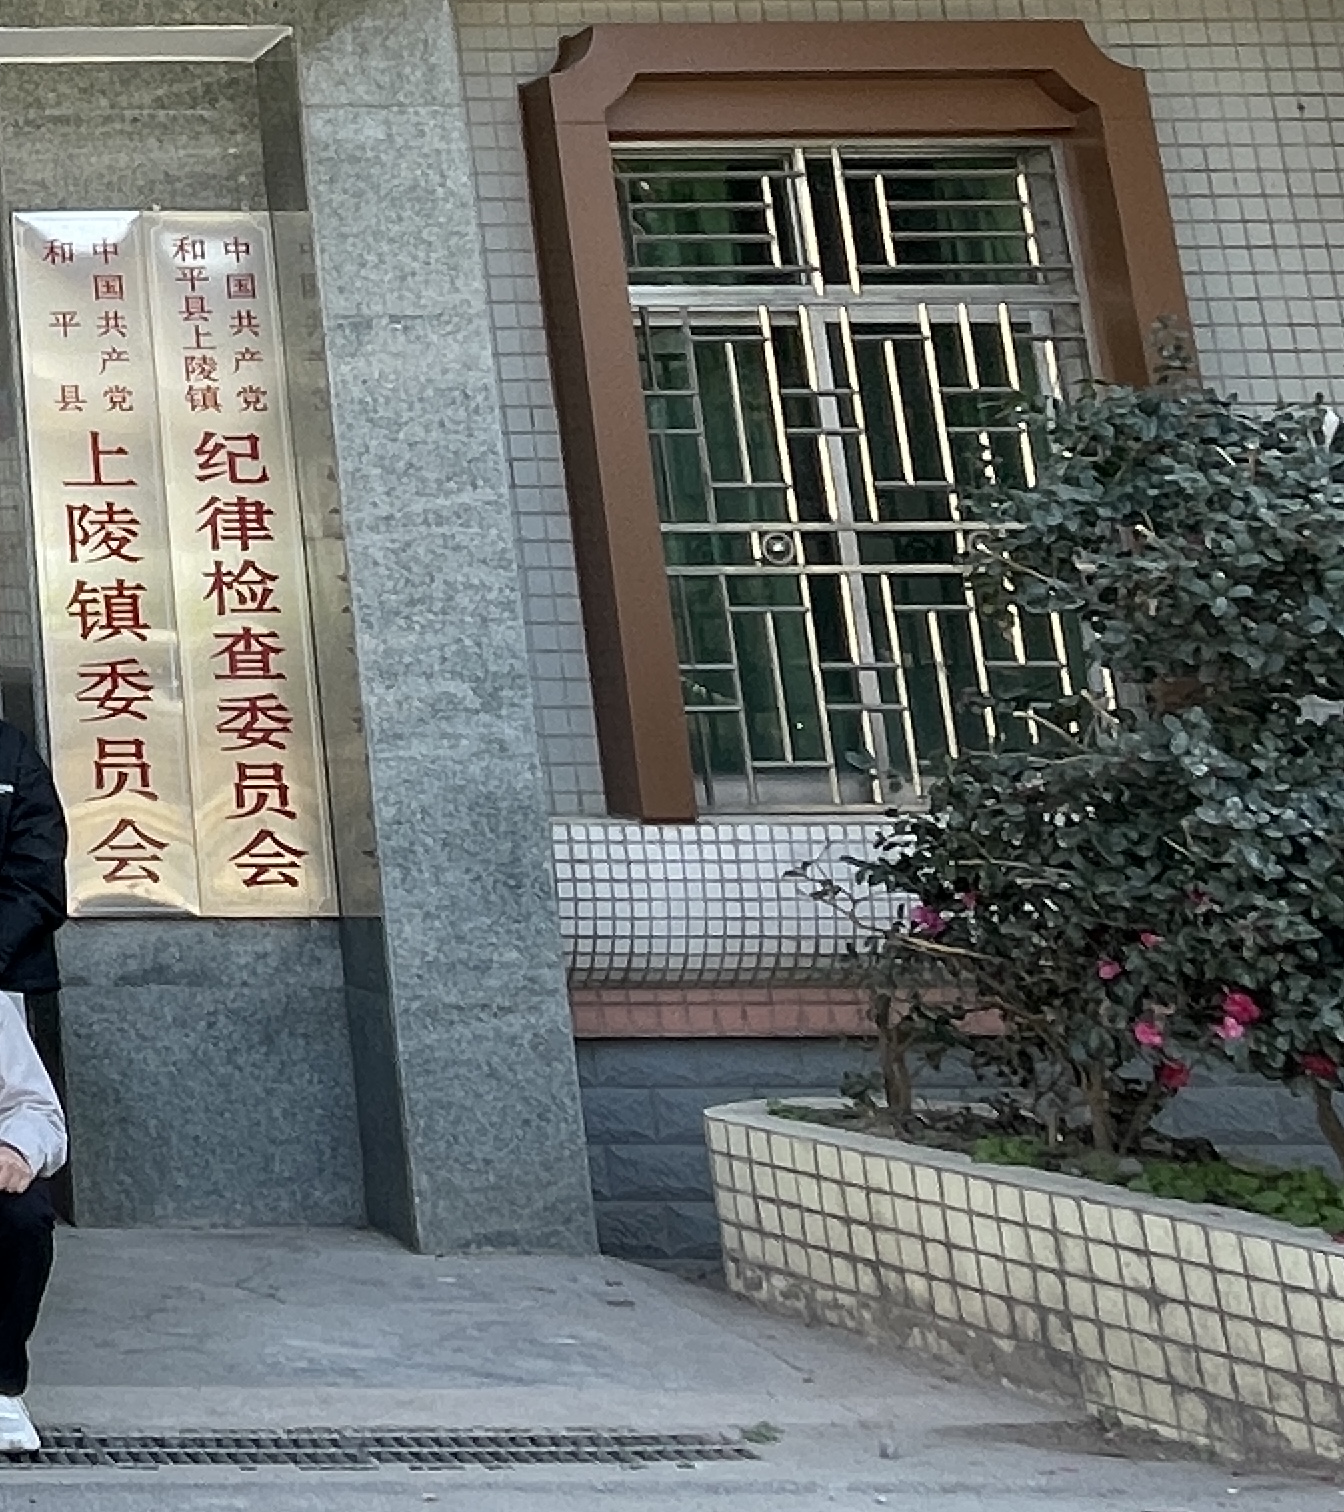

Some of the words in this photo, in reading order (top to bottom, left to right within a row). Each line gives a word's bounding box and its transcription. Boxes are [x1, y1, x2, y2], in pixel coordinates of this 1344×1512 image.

[42, 238, 88, 413] 和平县
[92, 237, 134, 413] 中国共产党
[172, 235, 223, 414] 和平县上陵镇
[223, 236, 268, 413] 中国共产党
[62, 429, 171, 886] 上陵镇委员会
[193, 429, 310, 890] 纪律检查委员会
